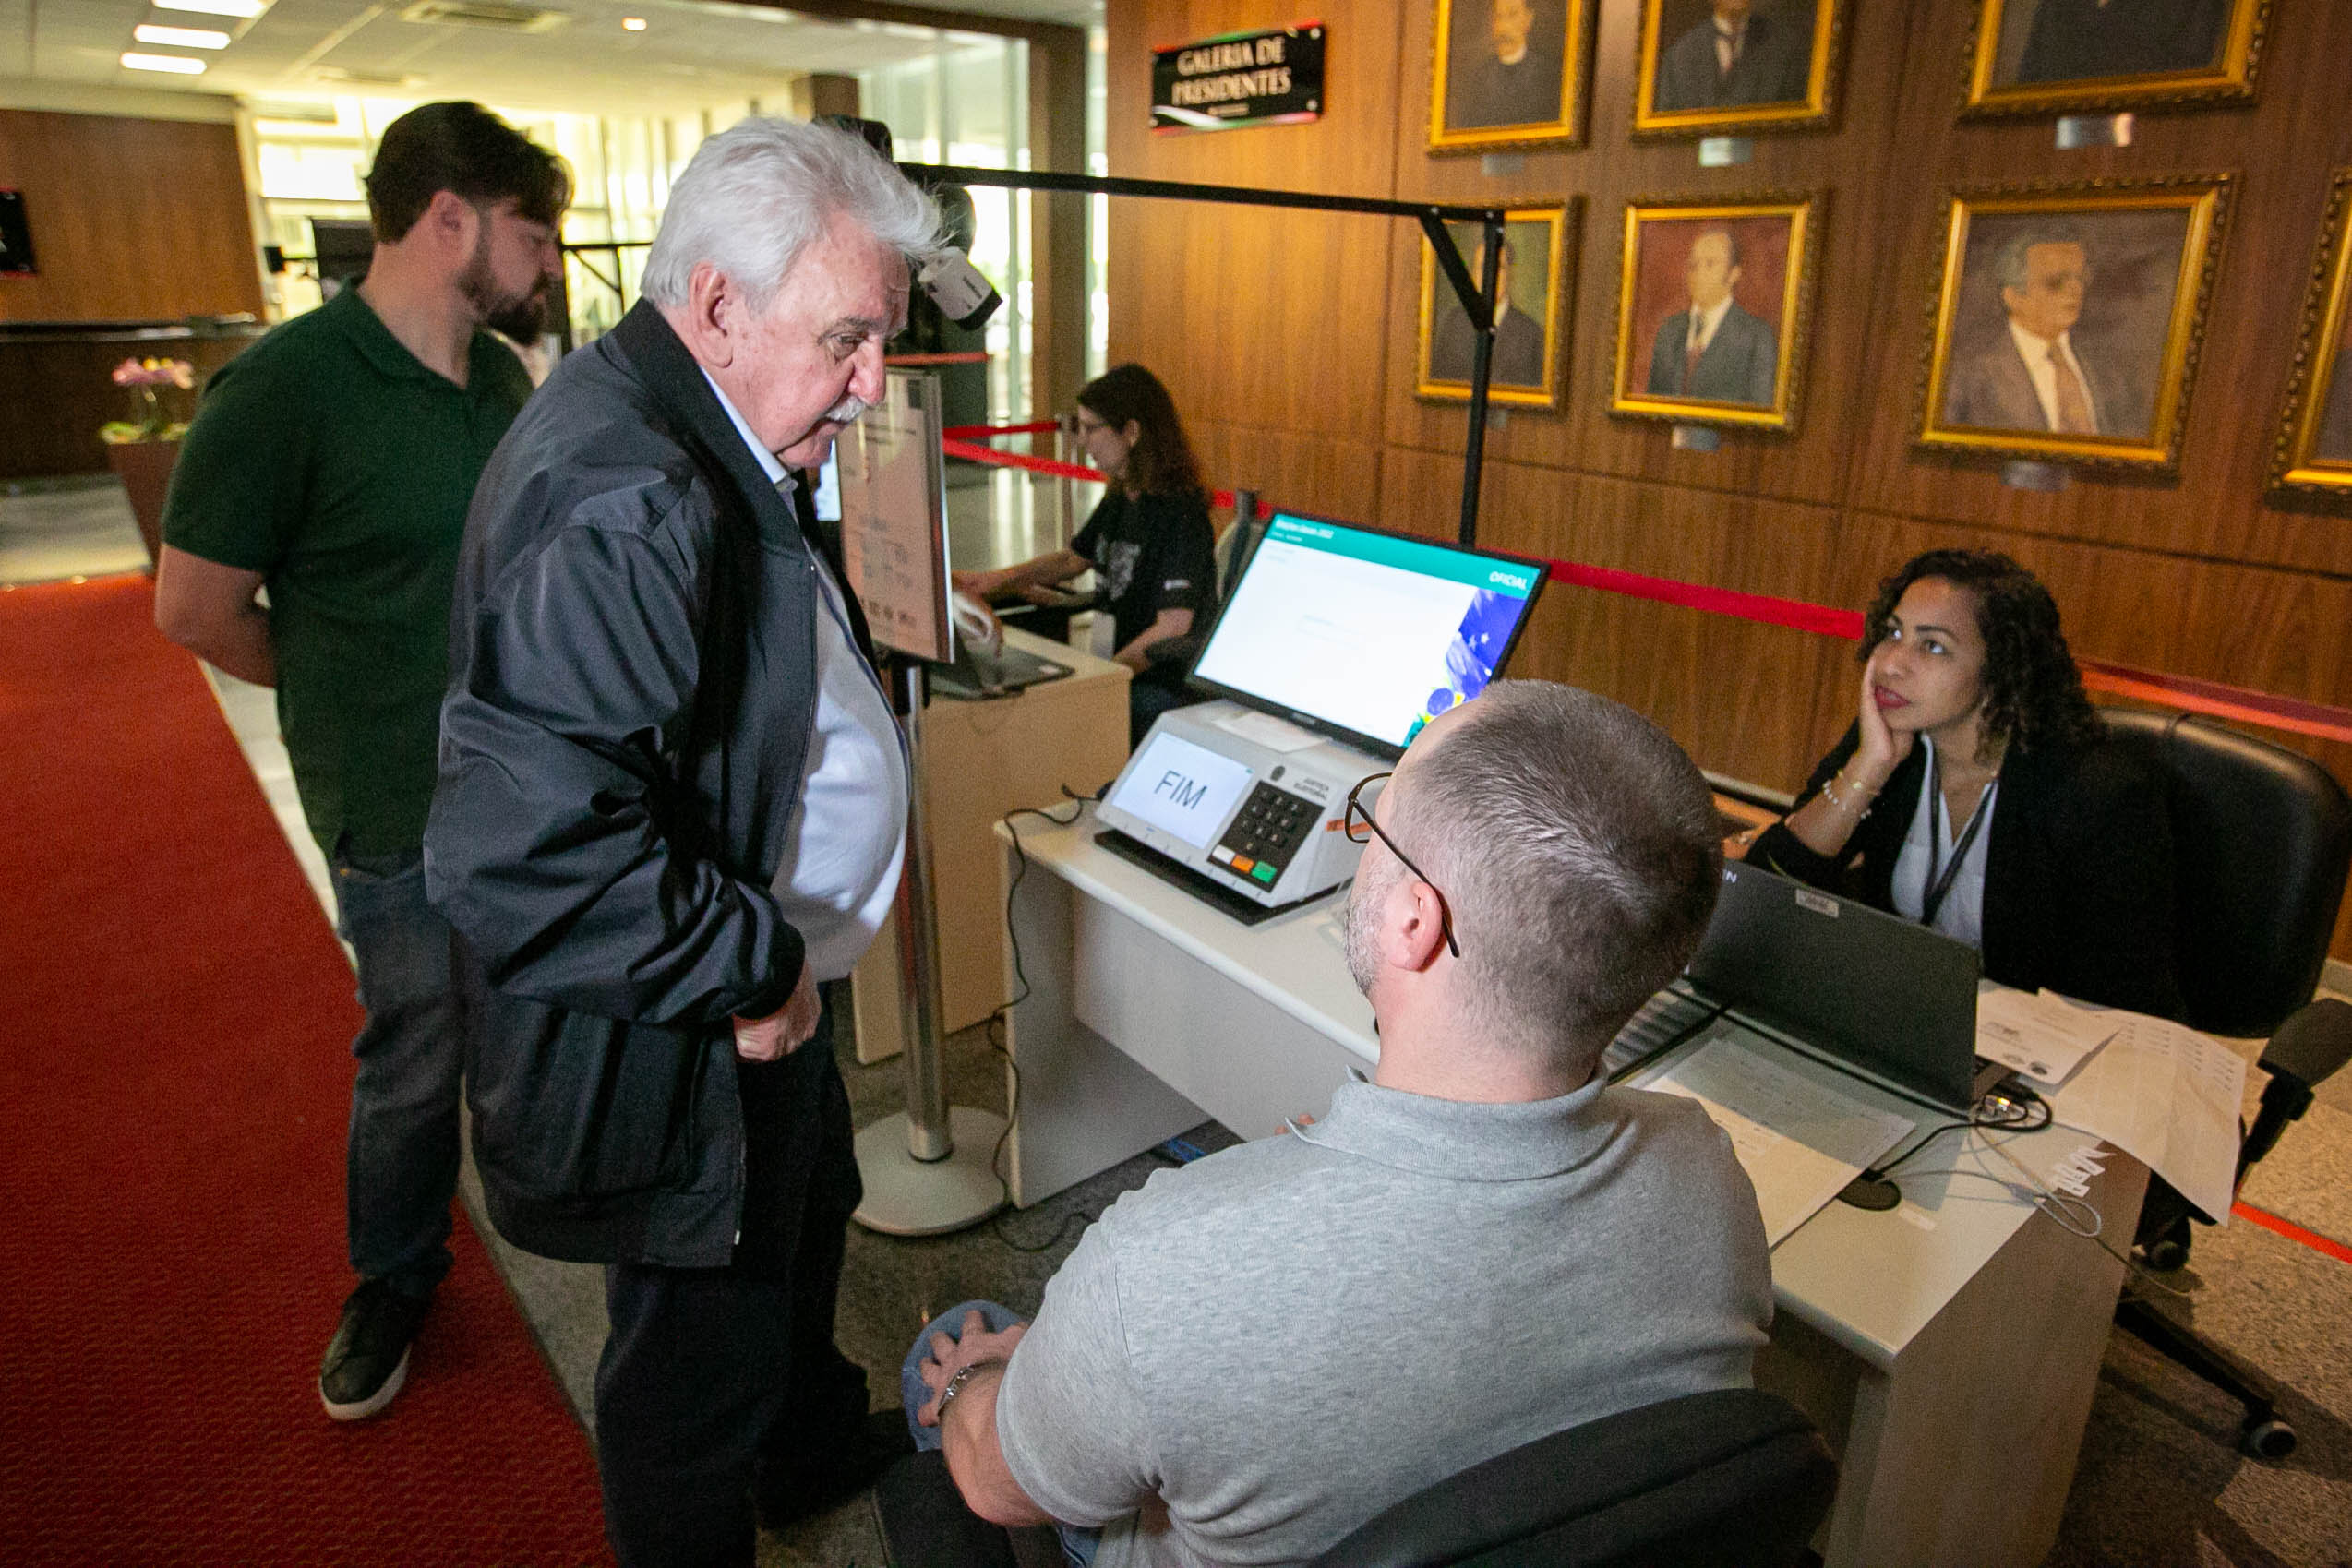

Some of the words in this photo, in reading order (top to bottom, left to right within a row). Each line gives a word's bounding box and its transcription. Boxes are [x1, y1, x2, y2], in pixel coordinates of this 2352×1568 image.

[1177, 42, 1254, 77] GALERIA
[1255, 36, 1286, 66] DE
[1171, 66, 1292, 106] PRESIDENTES
[1154, 770, 1207, 810] FIM
